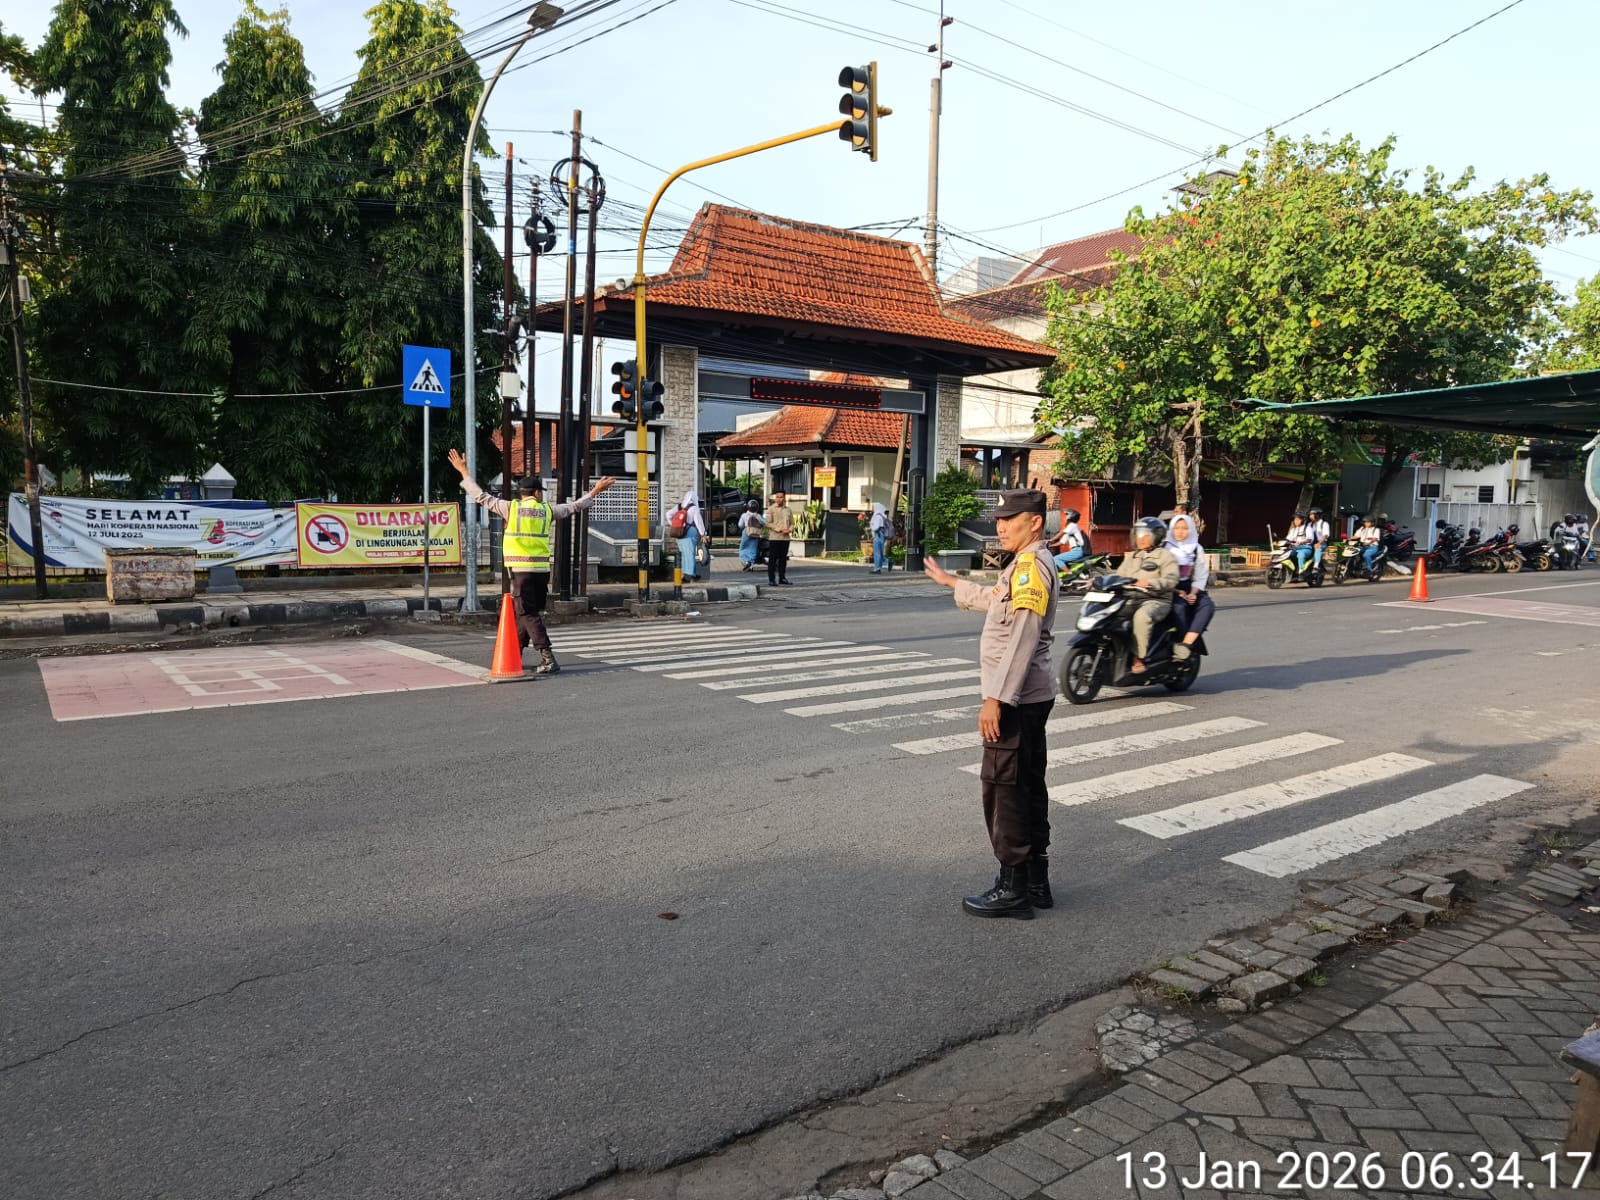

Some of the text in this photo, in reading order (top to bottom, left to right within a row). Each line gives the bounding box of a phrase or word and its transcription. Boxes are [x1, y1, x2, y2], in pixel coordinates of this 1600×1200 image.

[85, 508, 191, 521] SELAMAT
[355, 510, 450, 526] DILARANG
[121, 531, 144, 539] 2025
[356, 537, 454, 548] DI LINGKUNGAN SKOLAH
